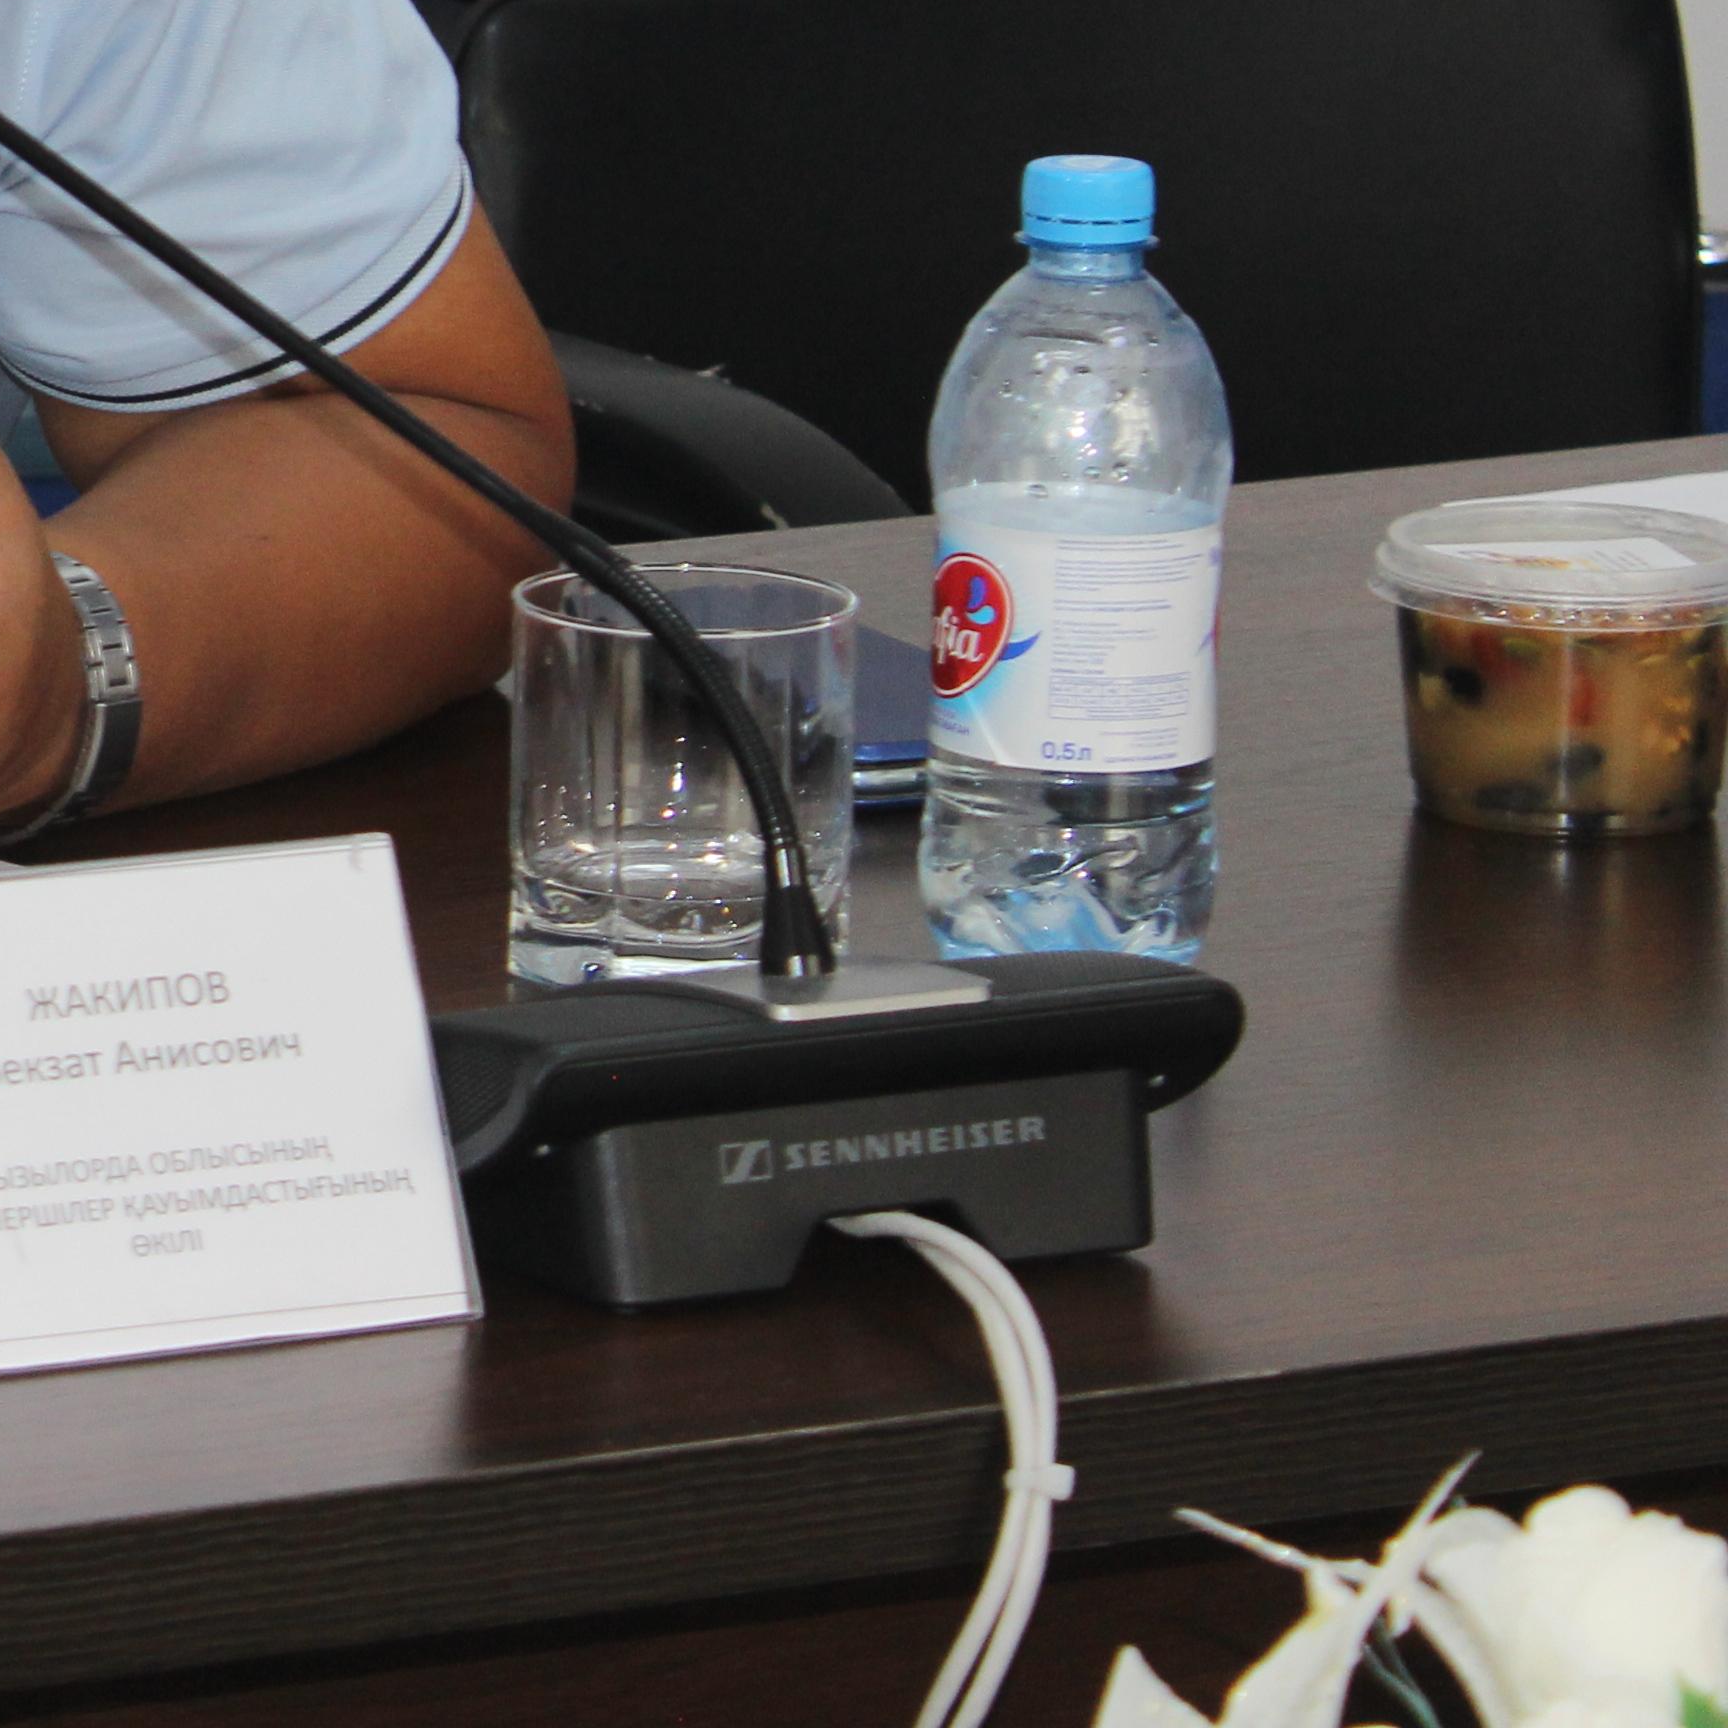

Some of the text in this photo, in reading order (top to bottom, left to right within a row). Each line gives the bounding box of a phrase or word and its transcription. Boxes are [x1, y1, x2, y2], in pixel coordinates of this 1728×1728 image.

[26, 970, 231, 1022] ЖАКИПОВ
[115, 1032, 303, 1074] Анисович
[148, 1135, 335, 1175] ОБЛЫСЫНЫҢ
[784, 1116, 1046, 1171] SENNHEISER
[121, 1168, 417, 1220] ҚАУЫМДАСТЫҒЫНЫҢ
[130, 1229, 206, 1257] ӨКІЛІ
